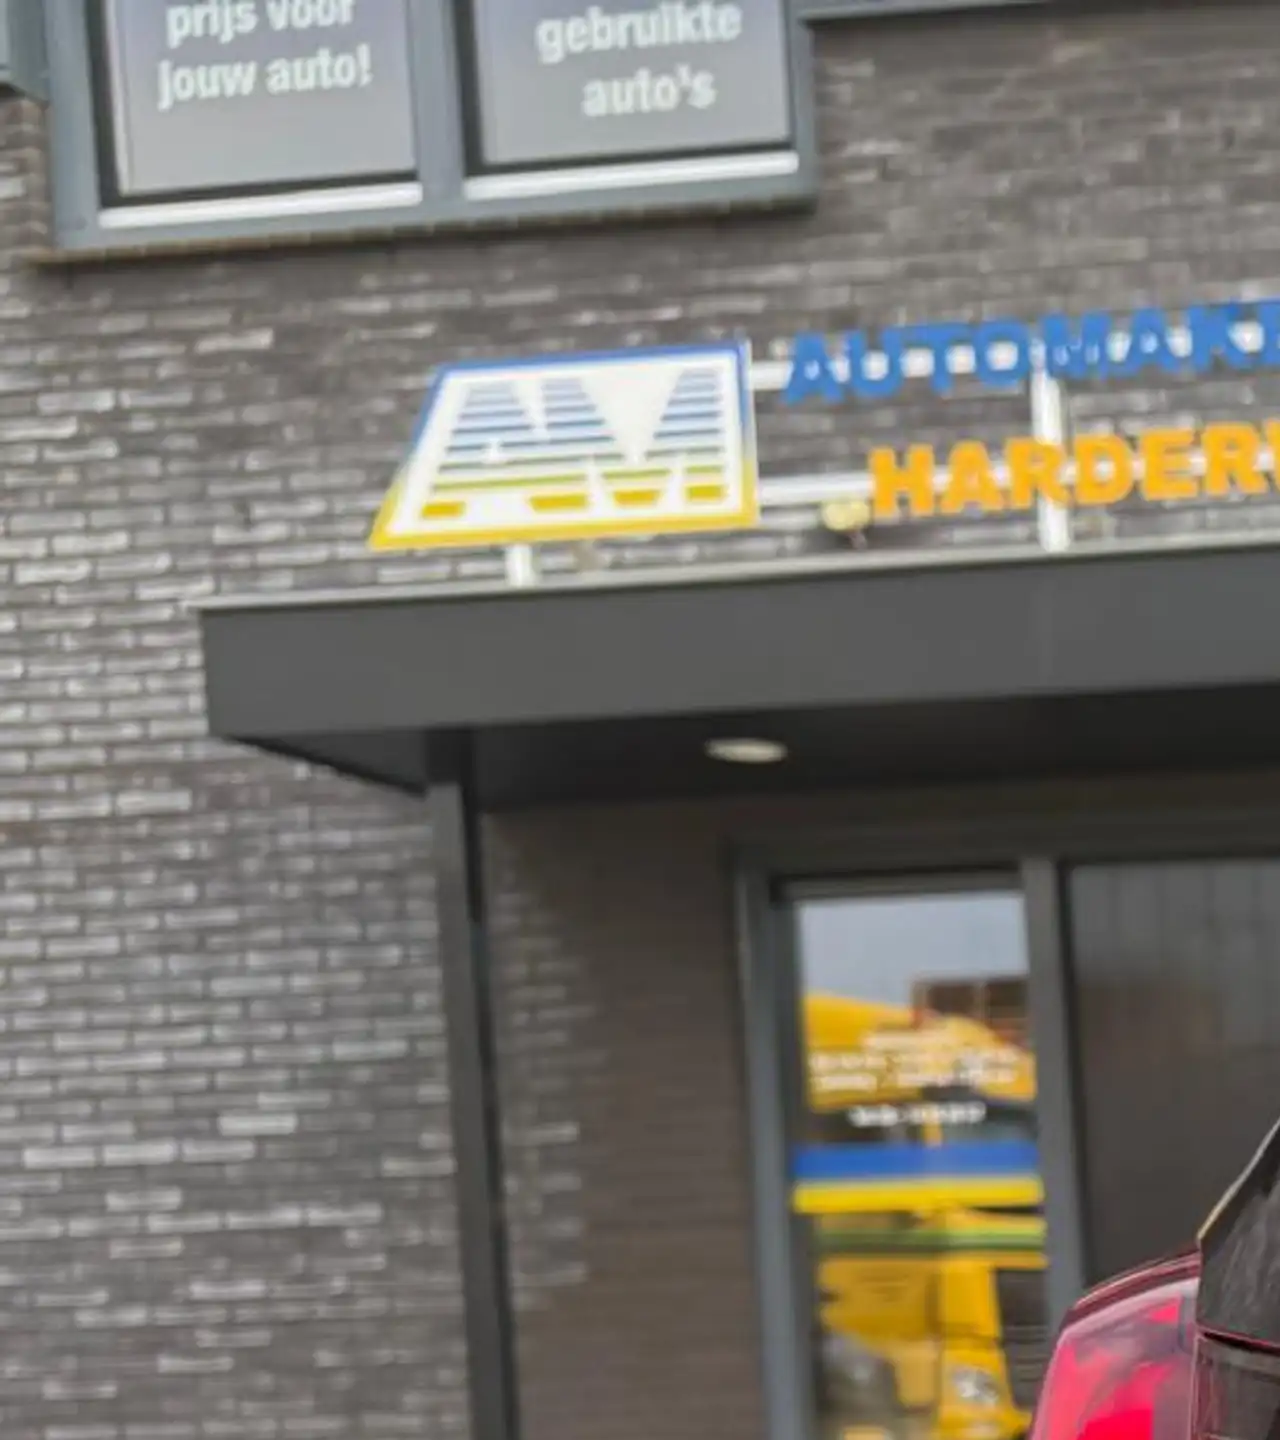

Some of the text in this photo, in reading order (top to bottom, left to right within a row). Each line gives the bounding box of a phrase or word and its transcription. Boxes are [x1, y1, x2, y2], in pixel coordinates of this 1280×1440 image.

[166, 0, 354, 49] prijs voor
[536, 1, 743, 65] gebruikte
[157, 42, 375, 112] jouw auto!
[581, 62, 719, 117] auto's
